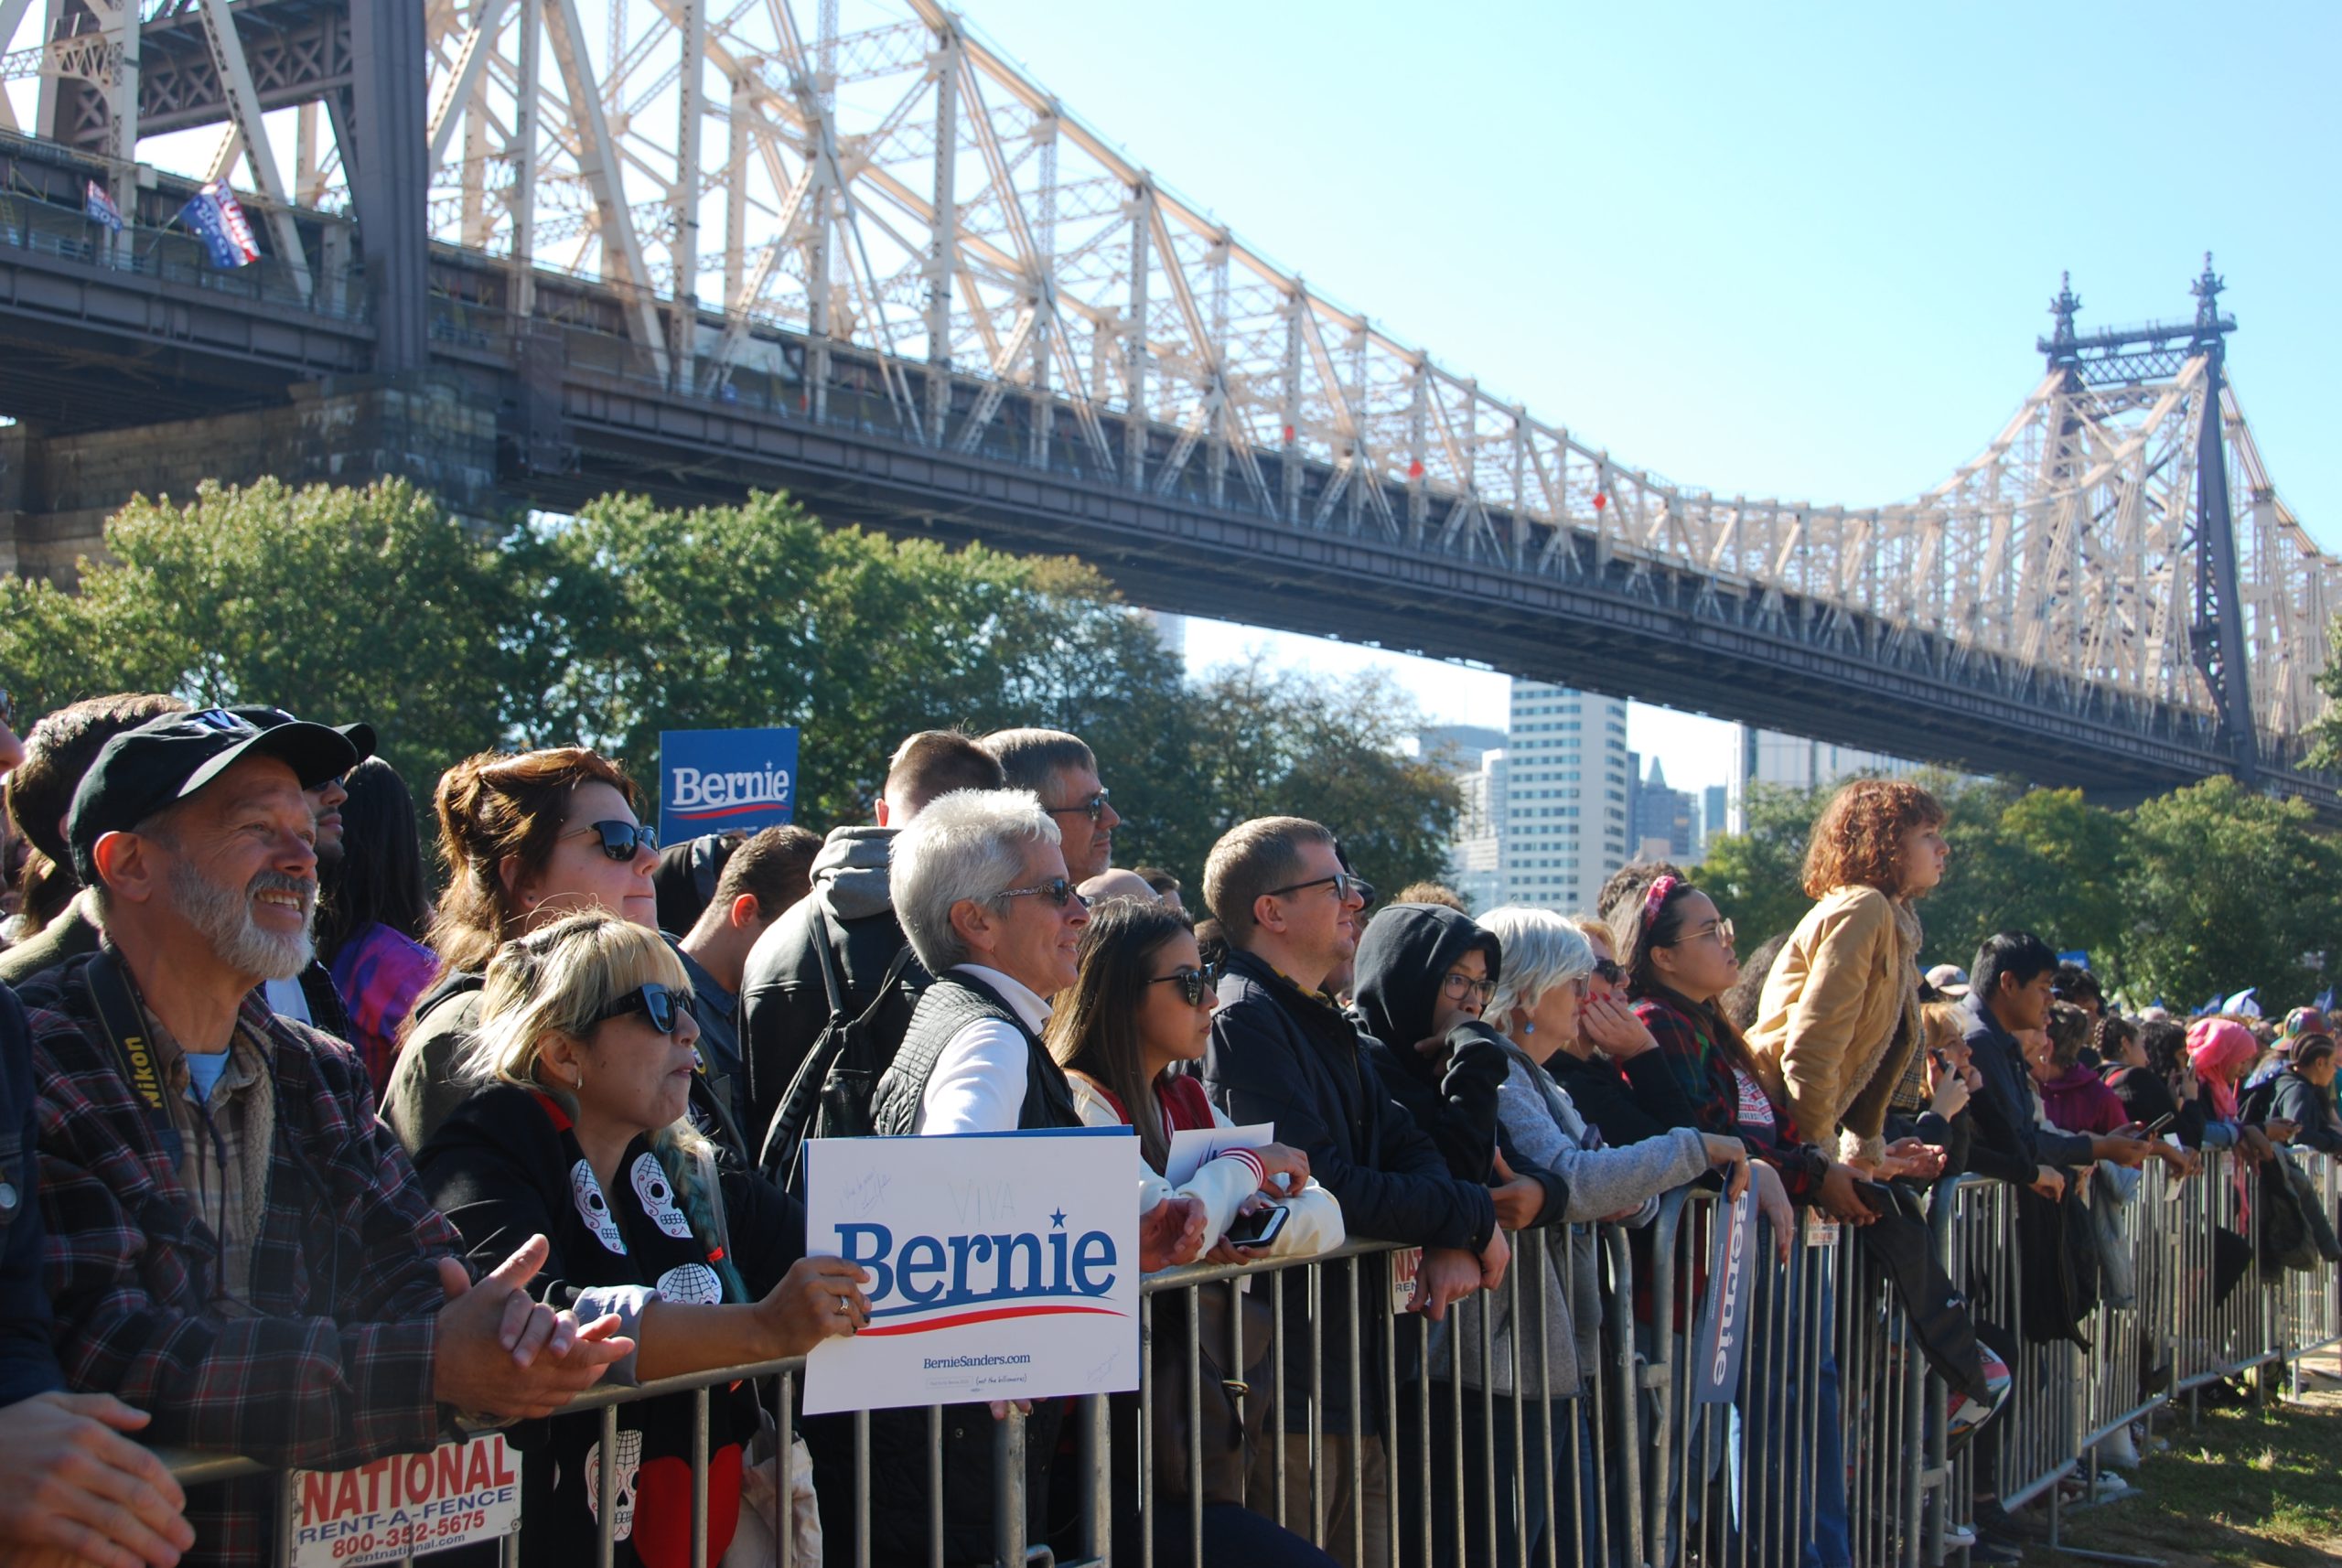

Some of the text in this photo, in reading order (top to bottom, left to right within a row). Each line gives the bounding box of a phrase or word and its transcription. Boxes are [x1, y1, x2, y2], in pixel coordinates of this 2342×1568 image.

[216, 177, 261, 257] TRUMP
[671, 760, 790, 806] Bernie
[124, 1036, 163, 1109] Nikon
[948, 1178, 1015, 1225] VIVA
[834, 1206, 1117, 1303] Bernie
[1713, 1190, 1748, 1387] Bernie
[924, 1354, 1031, 1369] BernieSanders.com
[303, 1435, 514, 1526] NATIONAL
[299, 1487, 514, 1545] RENT-A-FENCE
[332, 1510, 485, 1558] 800-352-5675
